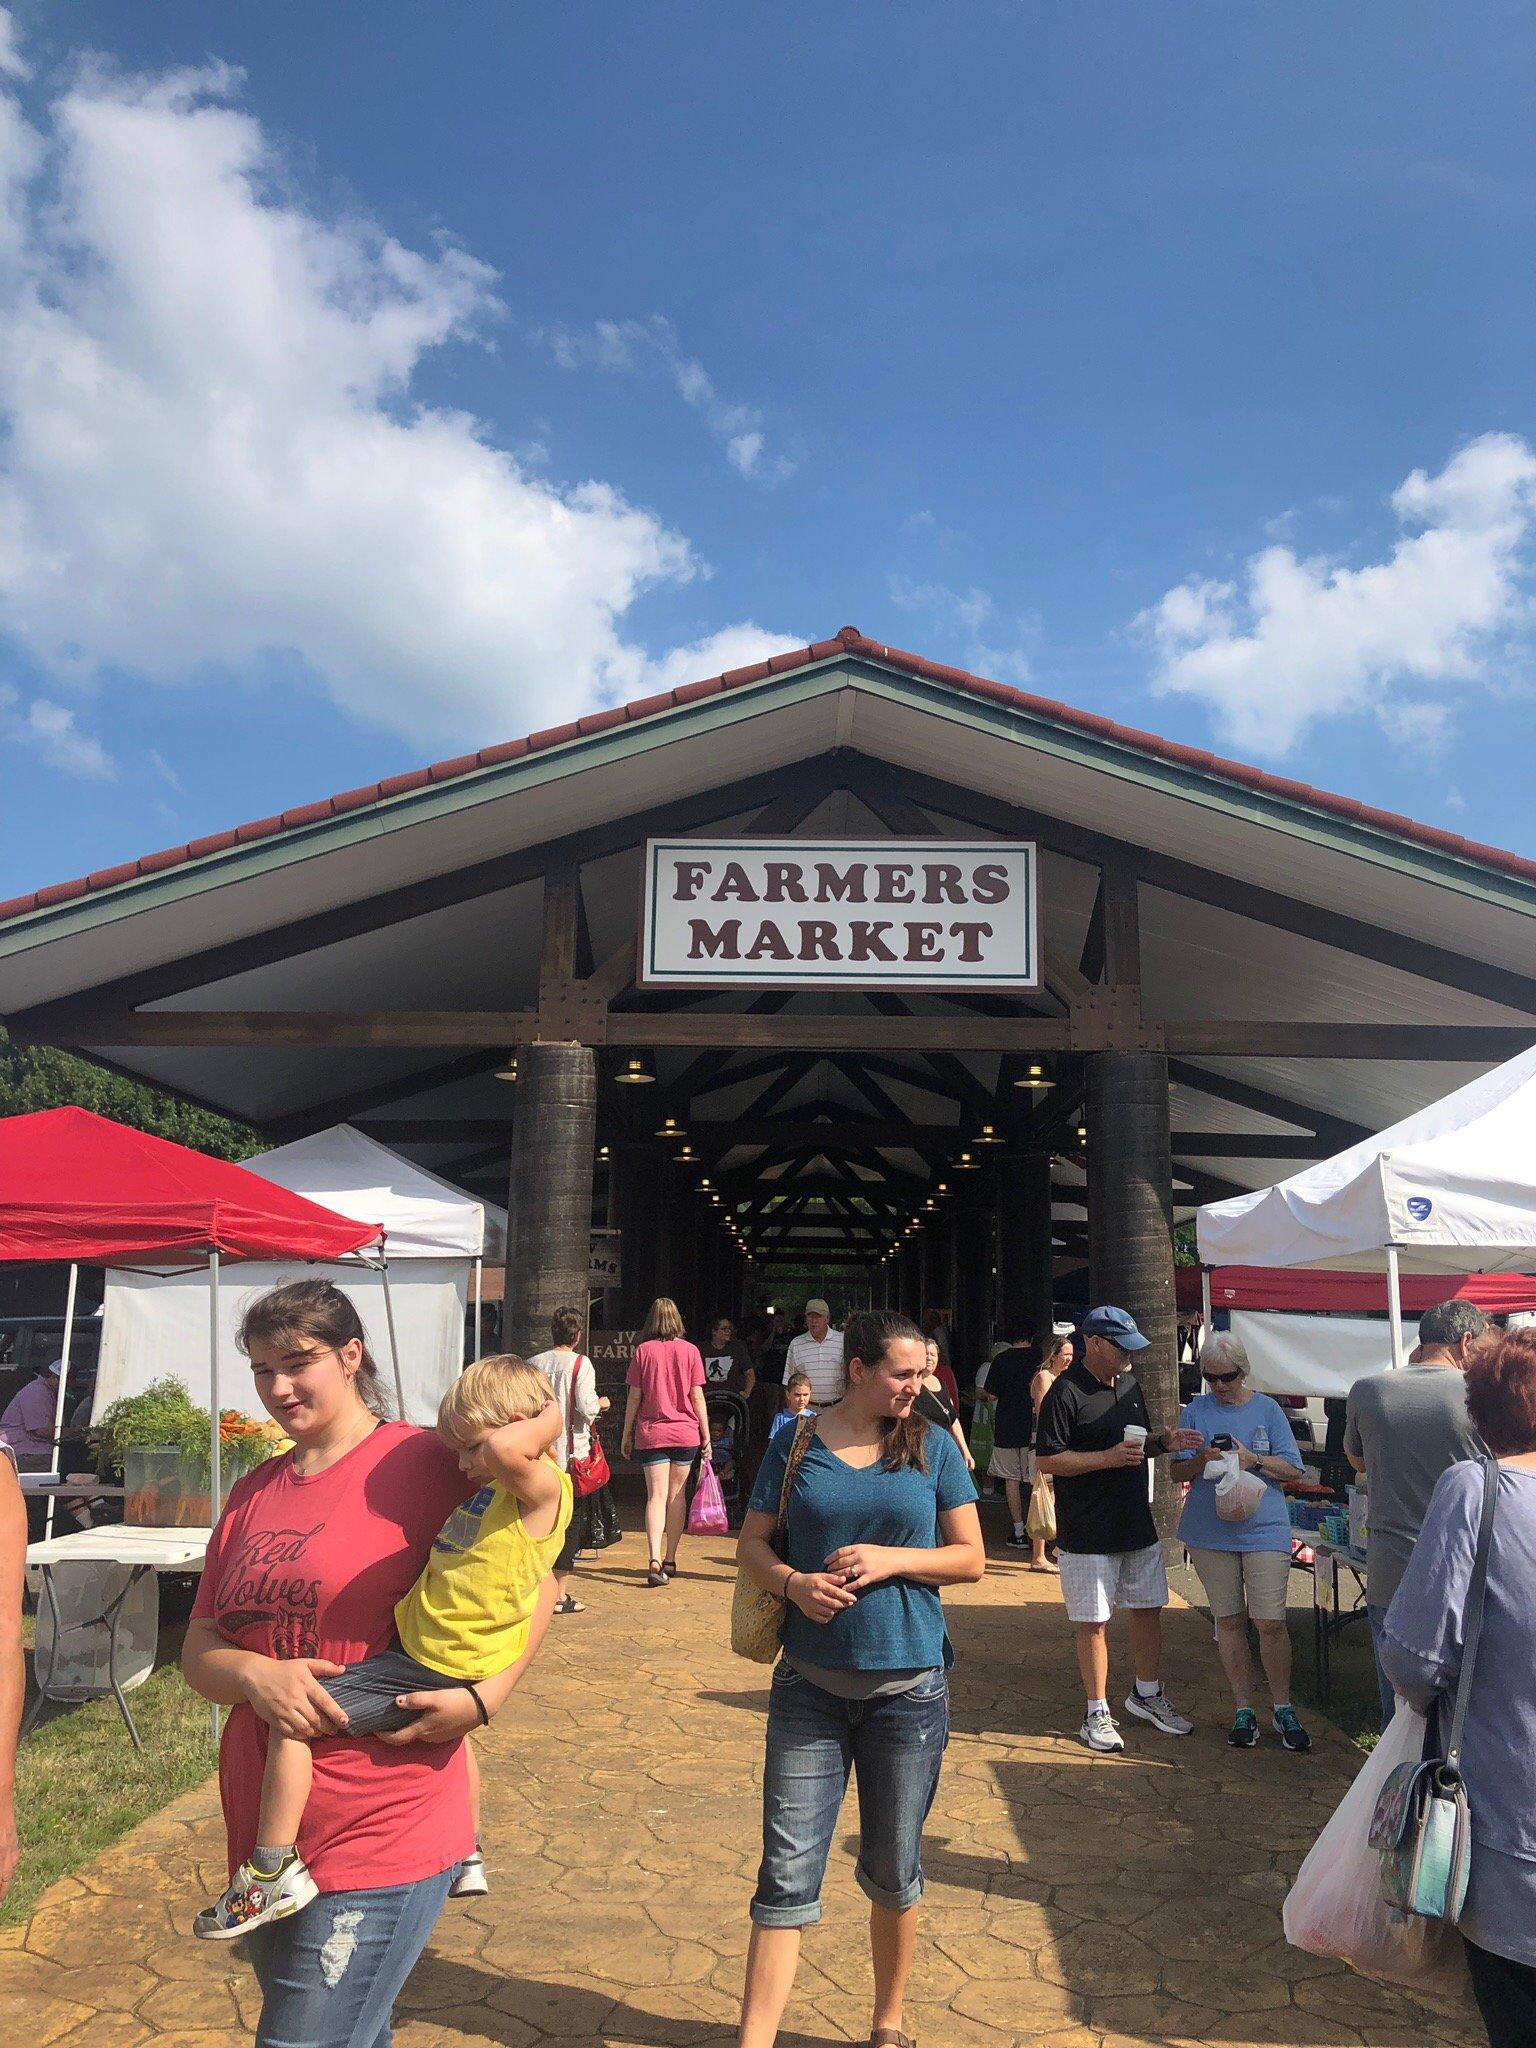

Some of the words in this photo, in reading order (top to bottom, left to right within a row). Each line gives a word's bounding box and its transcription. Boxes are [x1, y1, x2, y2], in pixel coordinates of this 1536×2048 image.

[672, 861, 1011, 905] FARMERS
[686, 918, 994, 963] MARKET
[613, 1330, 637, 1345] JV
[237, 1523, 325, 1567] Red
